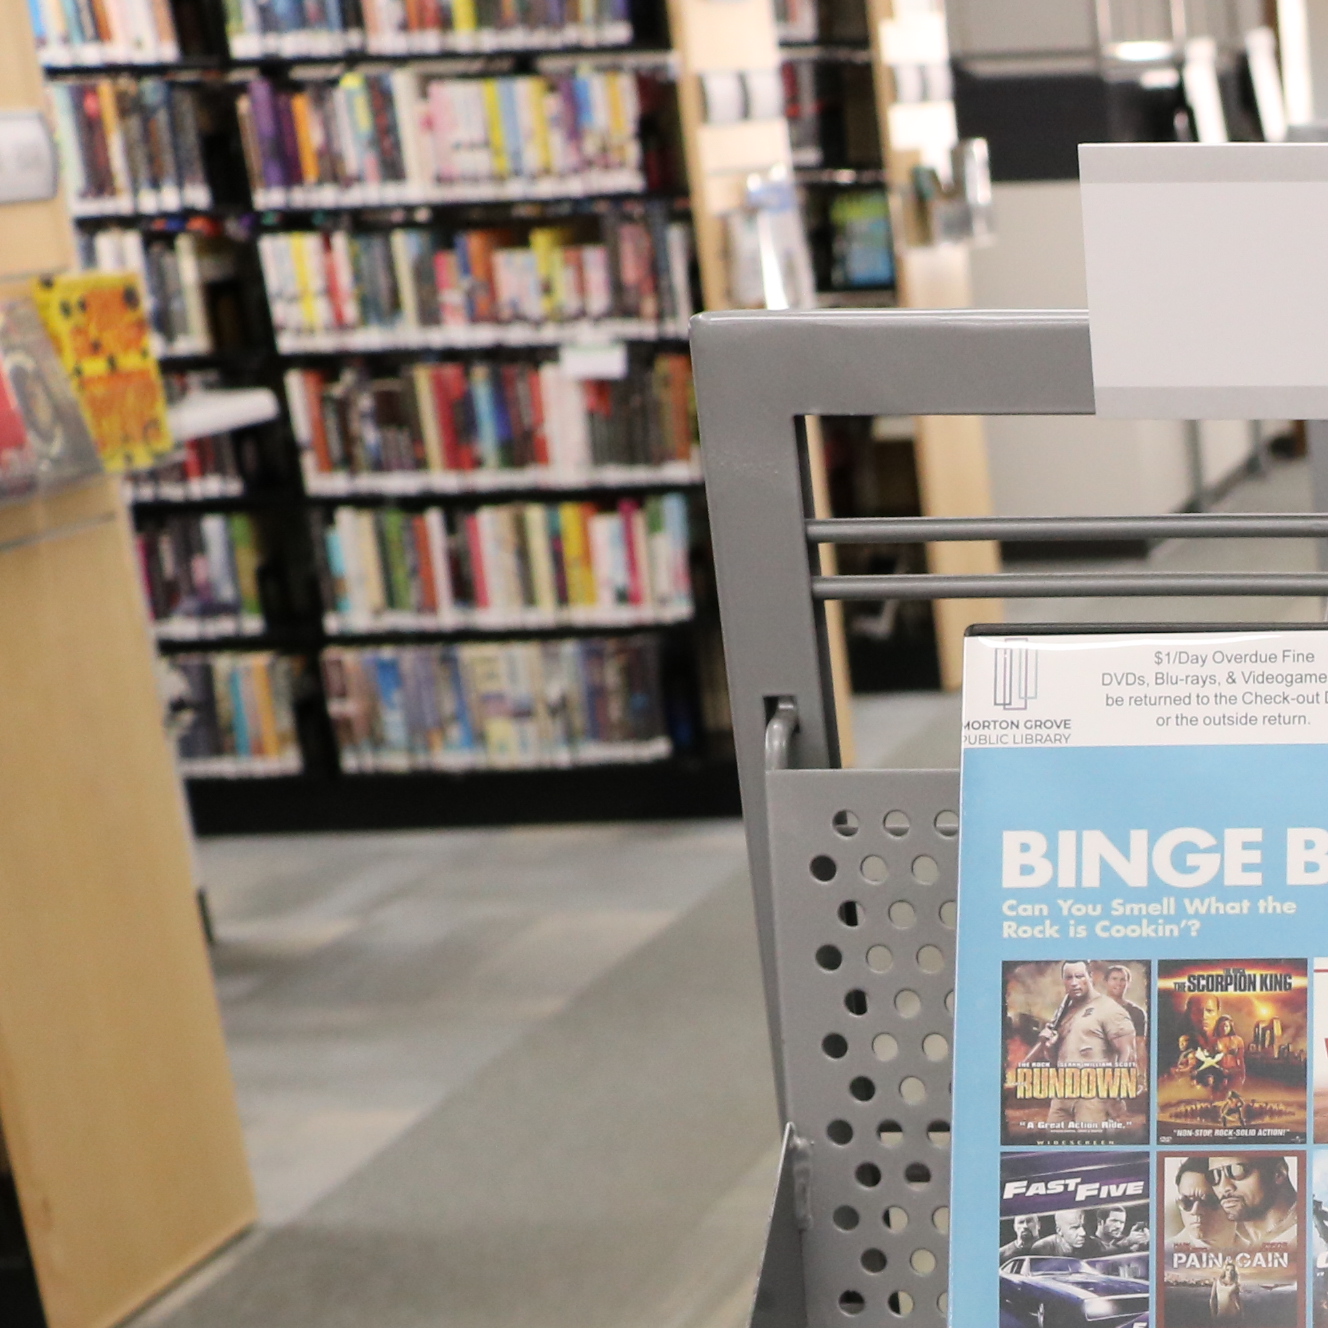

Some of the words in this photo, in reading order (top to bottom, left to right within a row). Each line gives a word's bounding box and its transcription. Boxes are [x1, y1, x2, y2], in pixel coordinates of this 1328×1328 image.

[1002, 828, 1263, 888] BINGE
[1003, 898, 1048, 917] Can
[1056, 898, 1102, 917] You
[1111, 897, 1176, 916] Smell
[1184, 897, 1243, 916] What
[1252, 896, 1296, 914] the
[1003, 920, 1059, 939] Rock
[1067, 919, 1087, 939] is
[1187, 974, 1256, 993] SCORPION
[1260, 974, 1292, 991] KING
[1017, 1068, 1138, 1099] RUNDOWN
[1003, 1178, 1080, 1200] FAST
[1075, 1181, 1144, 1201] FIVE
[1173, 1253, 1223, 1268] PAIN
[1235, 1253, 1289, 1268] GAIN
